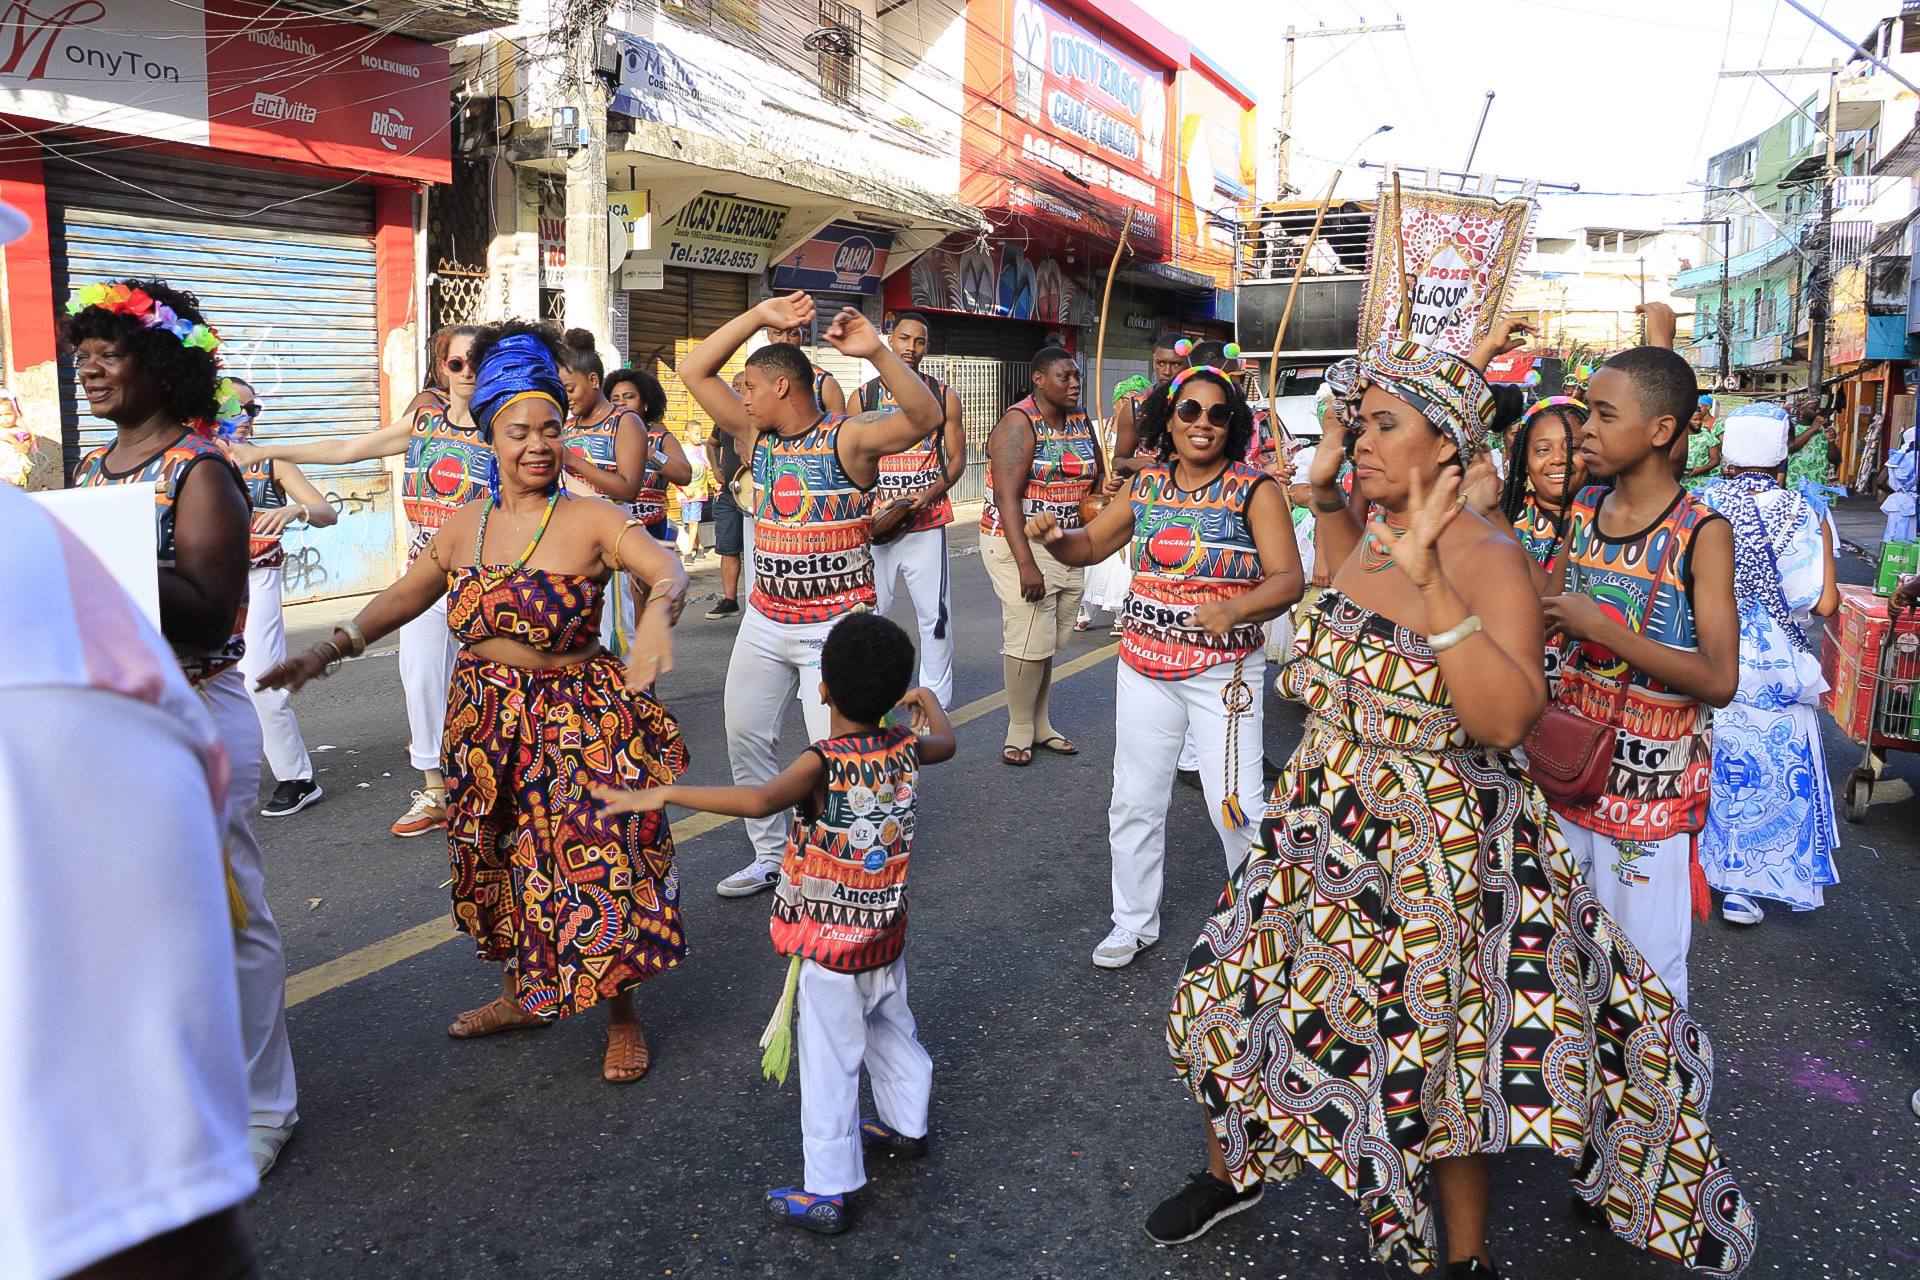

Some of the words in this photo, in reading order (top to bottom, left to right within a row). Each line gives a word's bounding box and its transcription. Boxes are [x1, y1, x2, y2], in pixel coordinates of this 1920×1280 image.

[361, 54, 420, 78] MOLEKINHO
[1052, 36, 1141, 116] UNIVERSO
[716, 201, 787, 241] LIBERDADE
[669, 242, 700, 263] Tel.:
[700, 246, 758, 270] 3242-8553
[836, 246, 872, 271] BAHIA
[1280, 369, 1296, 378] F10
[753, 553, 847, 578] espeito
[1593, 796, 1669, 827] 2026
[819, 923, 872, 944] Circuito
